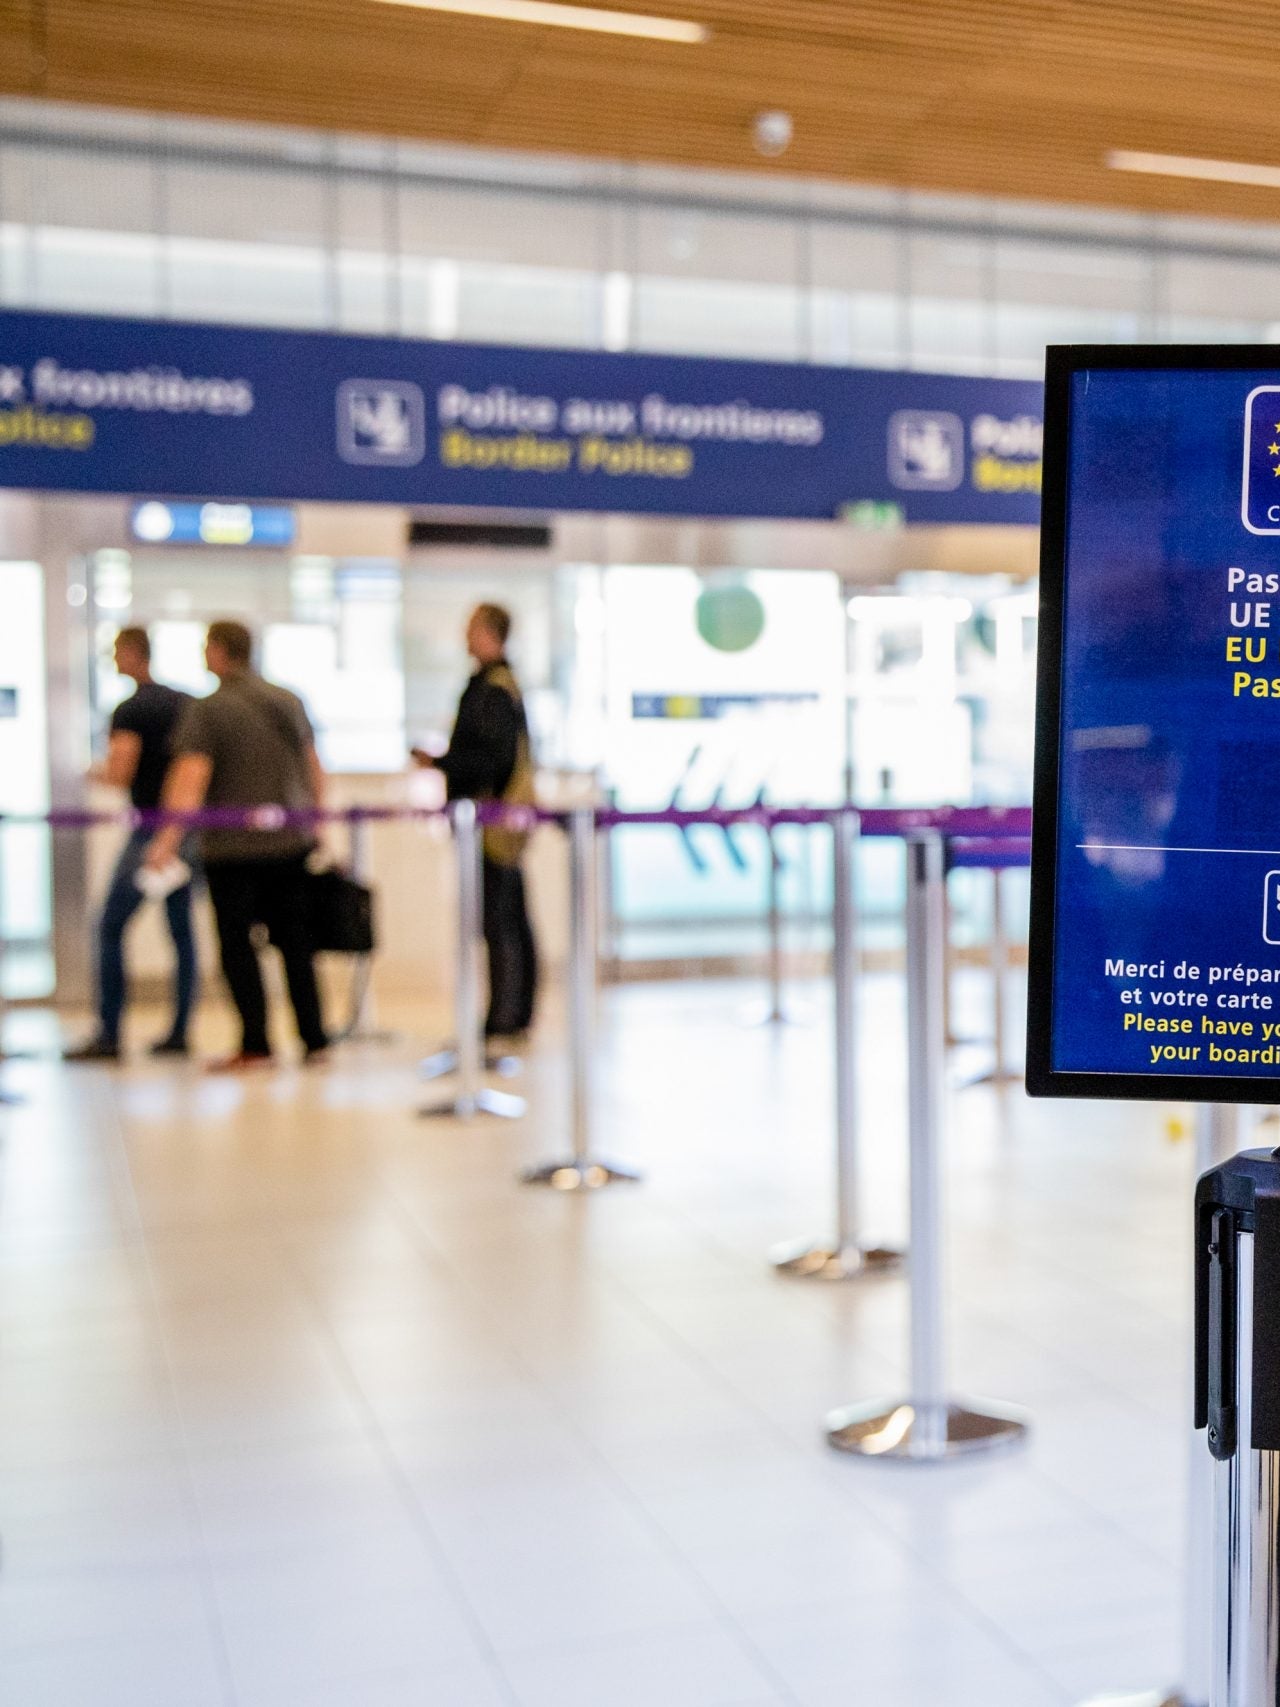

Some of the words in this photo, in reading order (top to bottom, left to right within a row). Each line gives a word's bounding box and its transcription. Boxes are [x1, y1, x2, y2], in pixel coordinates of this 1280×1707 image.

[1230, 602, 1271, 628] UE
[1226, 636, 1267, 663] EU
[1104, 958, 1165, 979] Merci
[1173, 960, 1200, 980] de
[1120, 988, 1143, 1005] et
[1150, 990, 1209, 1008] votre
[1216, 992, 1273, 1010] carte
[1123, 1012, 1193, 1034] Please
[1201, 1015, 1254, 1036] have
[1149, 1045, 1201, 1064] your
